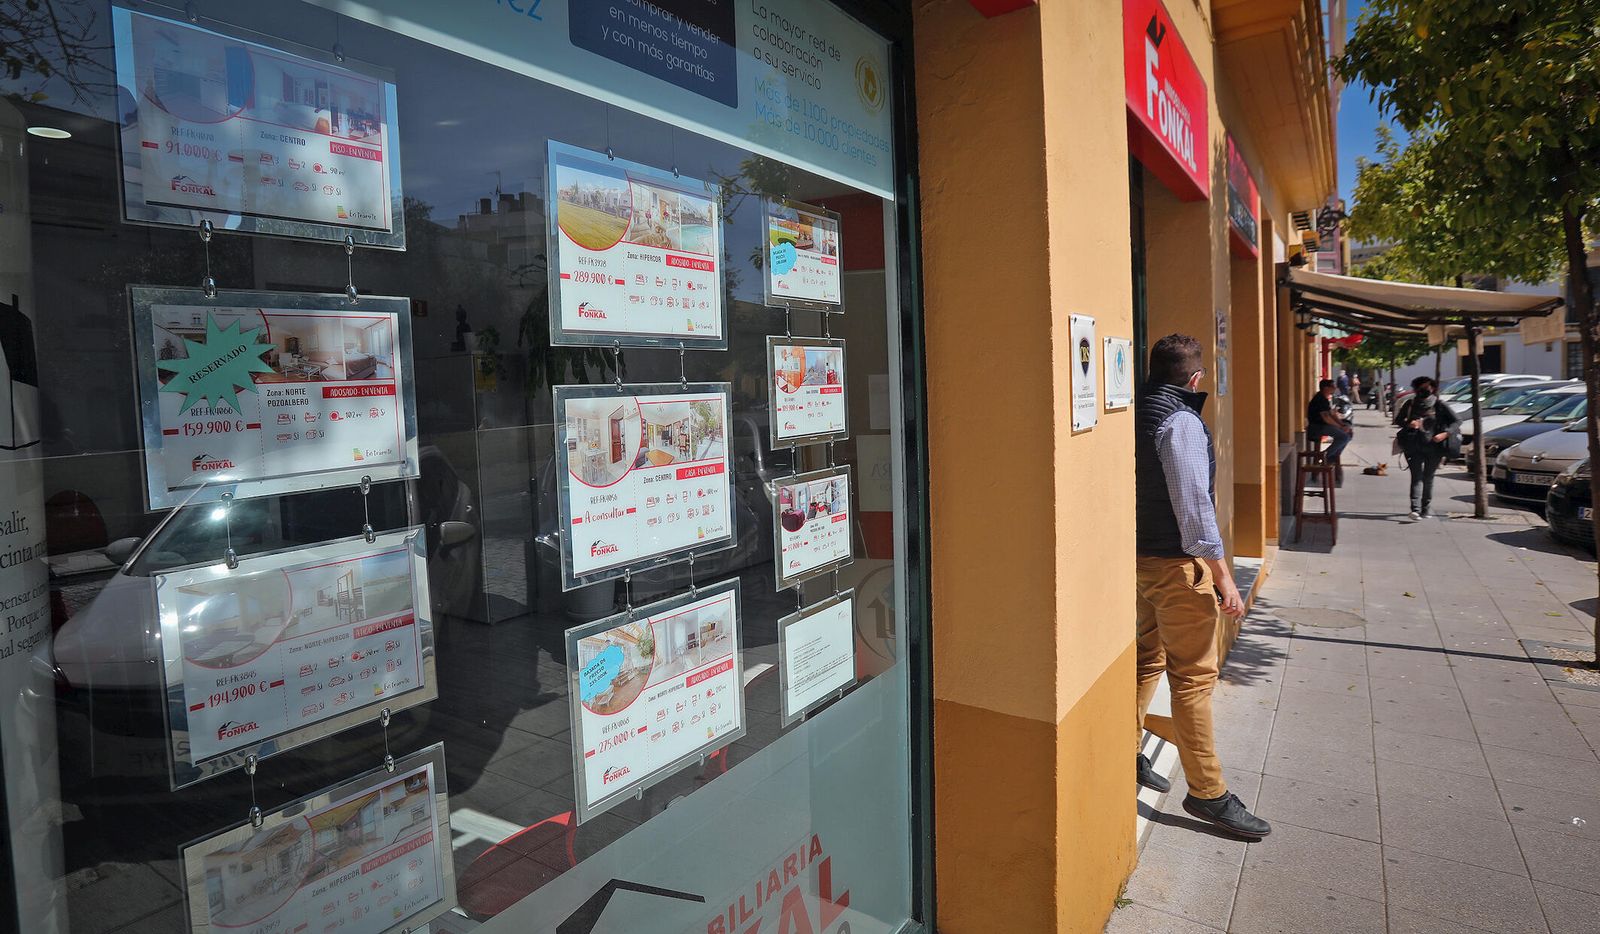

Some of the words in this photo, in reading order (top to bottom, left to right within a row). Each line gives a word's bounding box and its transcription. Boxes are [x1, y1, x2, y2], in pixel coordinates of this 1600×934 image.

[610, 6, 626, 22] en
[628, 14, 669, 42] menos
[671, 33, 708, 59] tiempo
[677, 16, 684, 30] y
[685, 21, 720, 46] vender
[752, 0, 767, 19] La
[771, 11, 806, 41] mayor
[809, 33, 826, 53] red
[828, 45, 841, 62] de
[601, 25, 609, 40] y
[613, 30, 635, 49] con
[638, 40, 664, 60] más
[754, 47, 762, 60] a
[765, 52, 779, 69] su
[782, 61, 822, 90] servicio
[1145, 34, 1198, 173] FONKAL
[785, 93, 800, 112] de
[831, 115, 890, 153] propiedades
[279, 134, 306, 146] CENTRO
[331, 143, 345, 153] PISO
[785, 117, 800, 136] de
[842, 142, 876, 168] clientes
[166, 141, 210, 160] 91.000
[171, 179, 216, 196] FONKAL
[574, 270, 606, 285] 289.900
[578, 307, 608, 319] FONKAL
[188, 343, 248, 385] RESERVADO
[285, 388, 307, 396] NORTE
[330, 388, 357, 397] ADOSADO
[369, 386, 388, 395] VENTA
[267, 398, 309, 407] POZOALBERO
[182, 420, 231, 437] 159.900
[236, 420, 244, 432] €
[192, 461, 236, 472] FONKAL
[585, 510, 591, 523] A
[592, 506, 625, 521] consultar
[591, 546, 619, 557] FONKAL
[208, 683, 256, 708] 194.900
[260, 681, 268, 693] €
[217, 724, 260, 741] FONKAL
[599, 731, 628, 754] 275.000
[603, 767, 631, 785] FONKAL
[329, 869, 360, 889] HIPERCOR
[707, 833, 823, 934] BILIARIA
